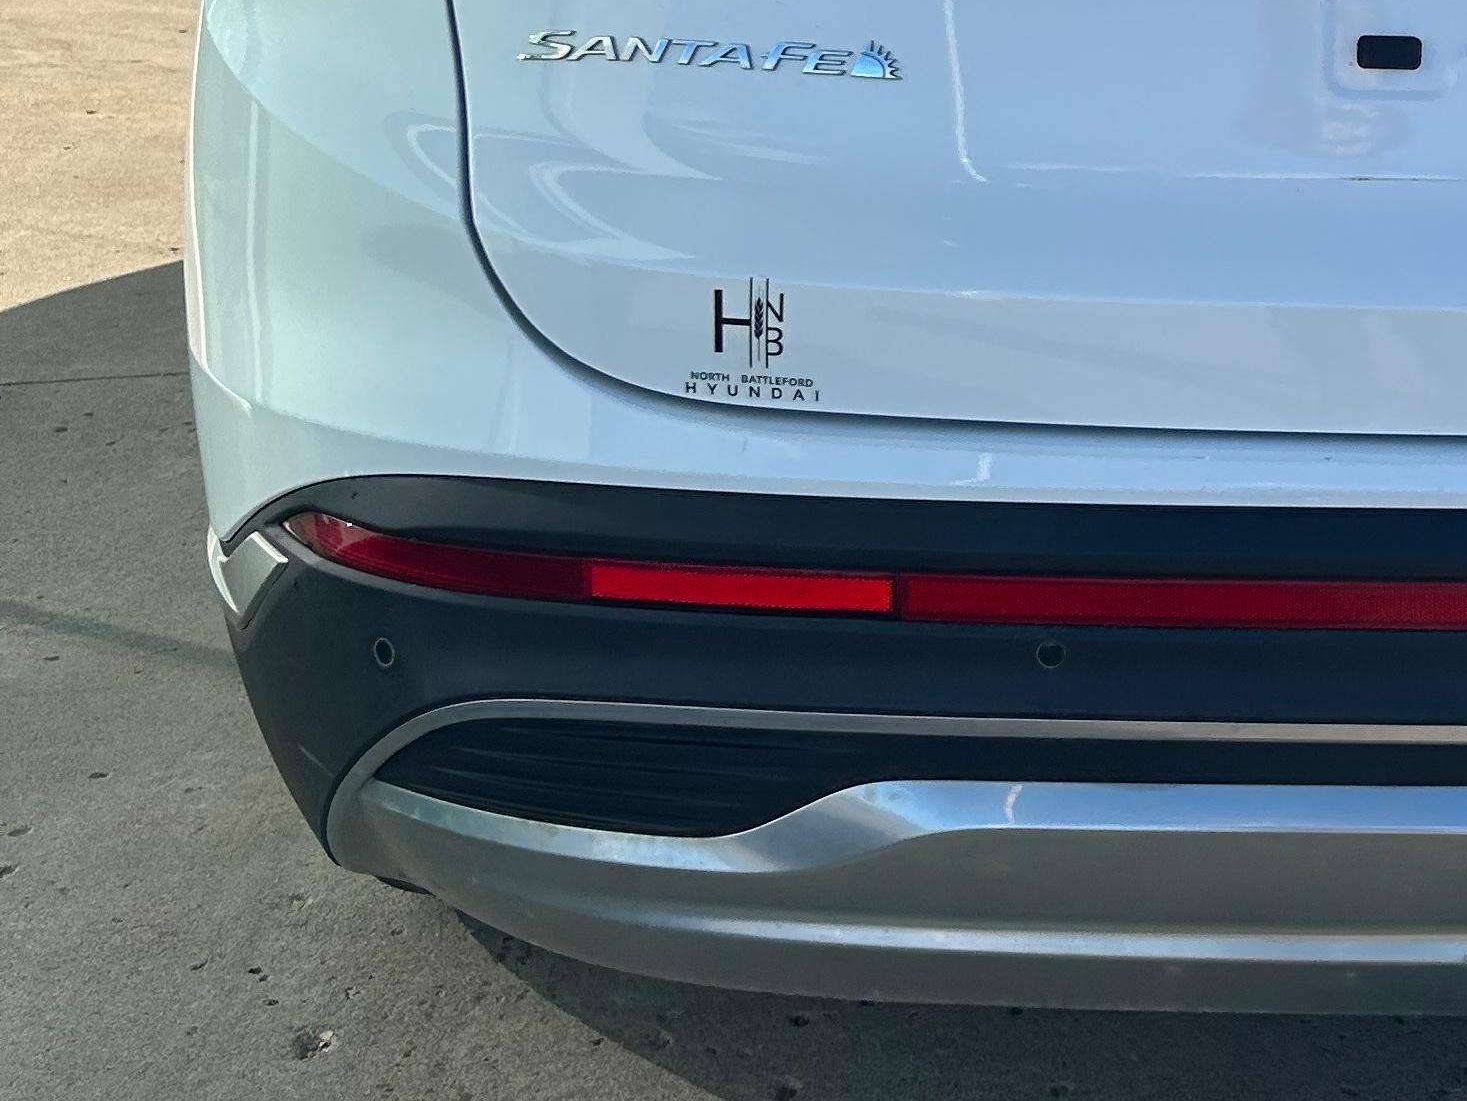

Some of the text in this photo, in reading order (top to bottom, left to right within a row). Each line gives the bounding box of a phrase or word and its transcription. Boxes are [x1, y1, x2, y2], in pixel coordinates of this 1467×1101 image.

[516, 30, 755, 70] SANTA
[690, 371, 814, 387] NORTH BATTLEFORD
[685, 382, 819, 401] HYUNDAI
